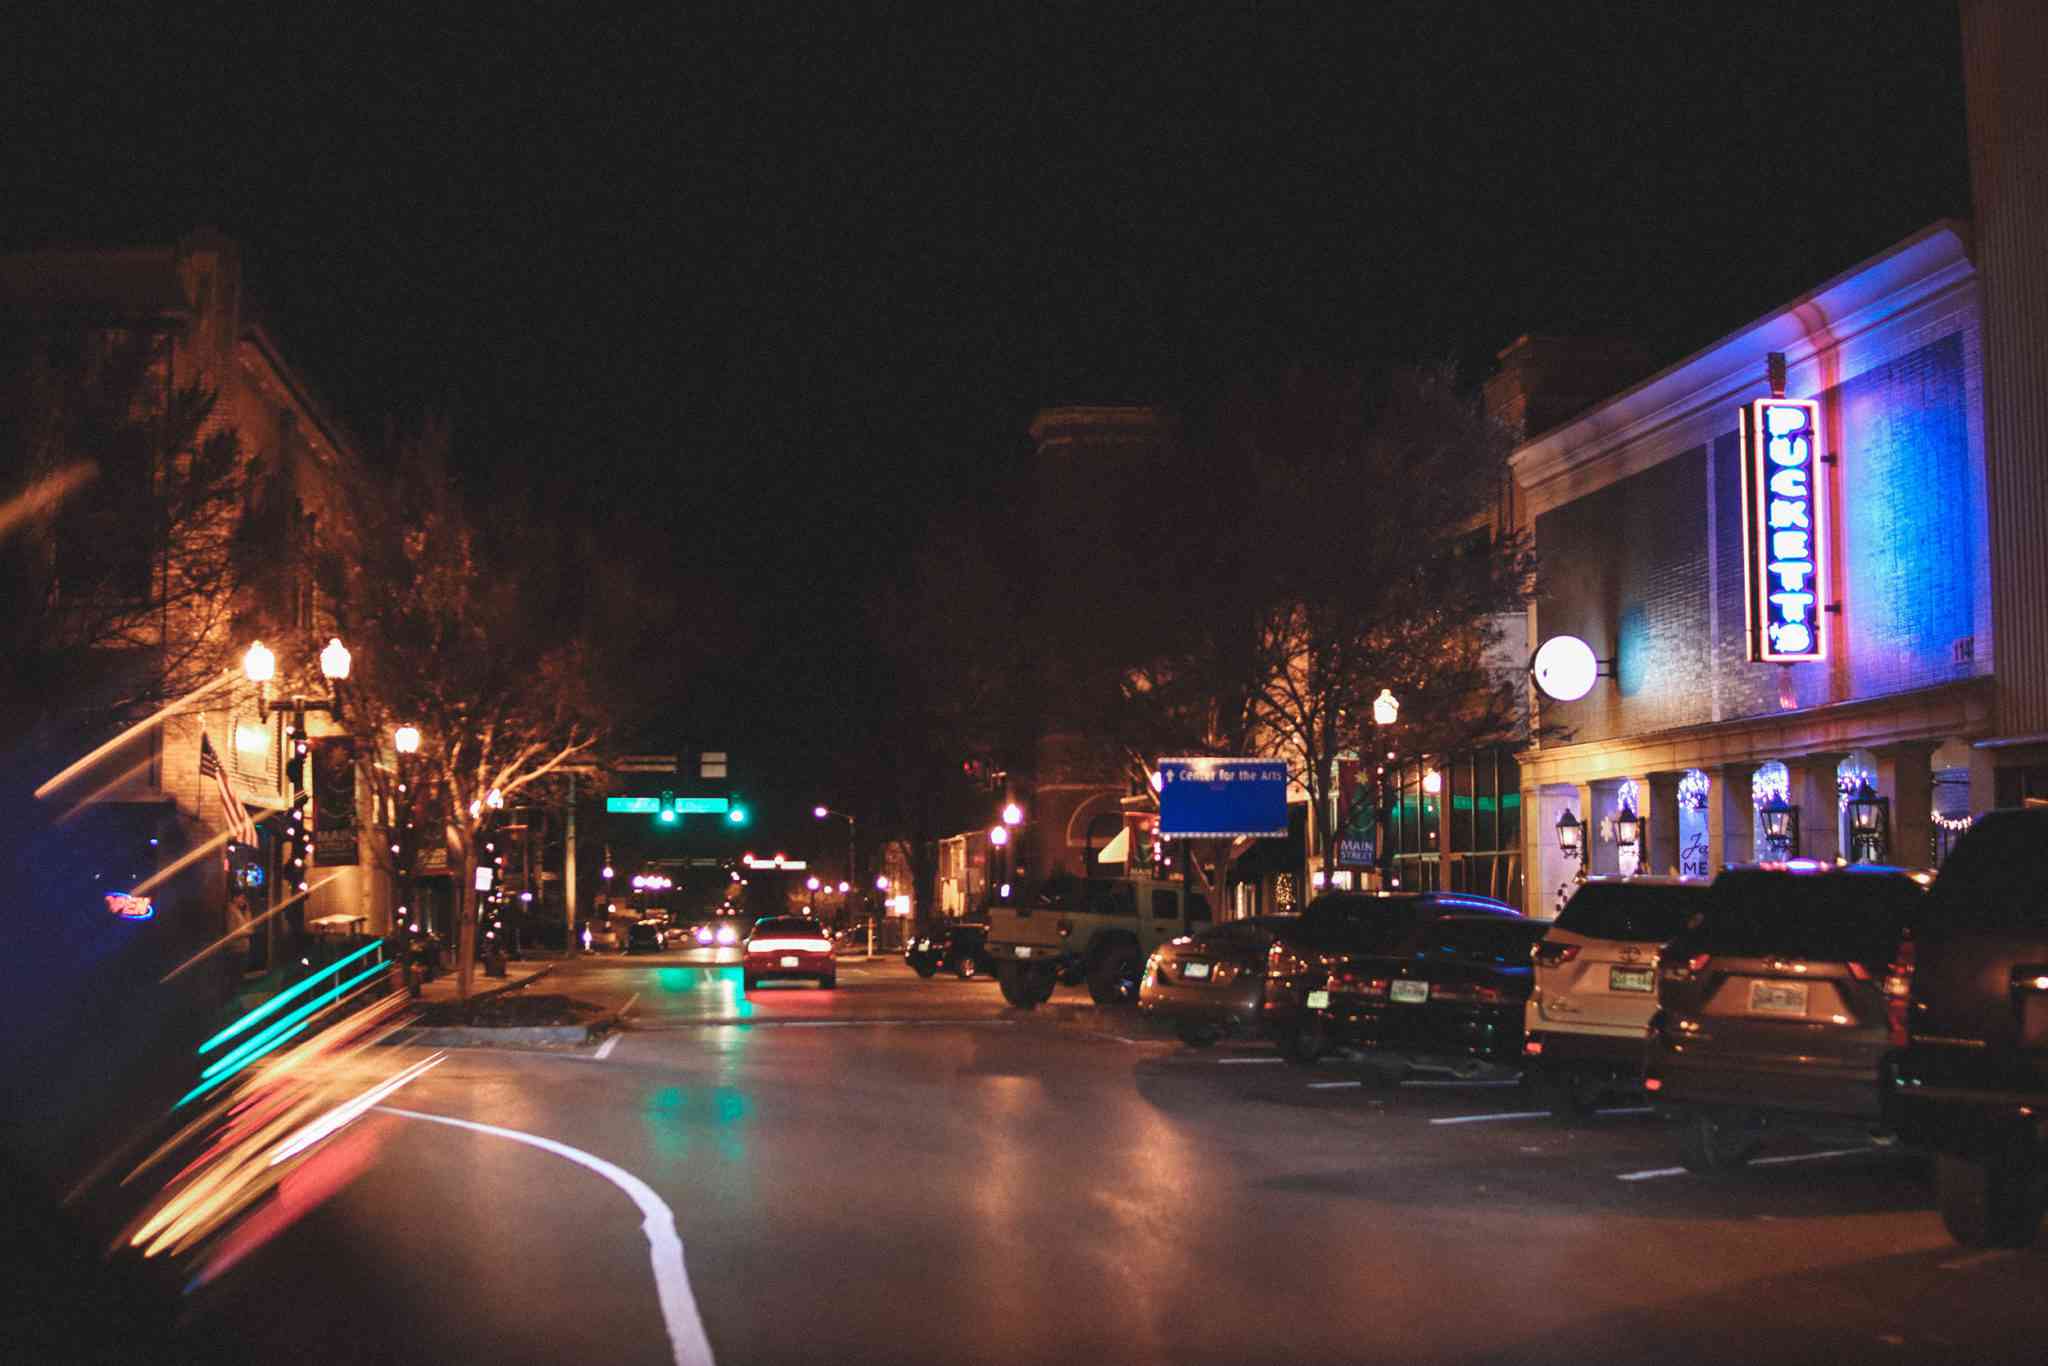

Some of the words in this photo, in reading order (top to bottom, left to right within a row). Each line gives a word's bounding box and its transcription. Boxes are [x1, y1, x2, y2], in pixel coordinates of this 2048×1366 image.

[1219, 769, 1235, 781] for
[1238, 770, 1256, 781] the
[1340, 840, 1373, 851] MAIN
